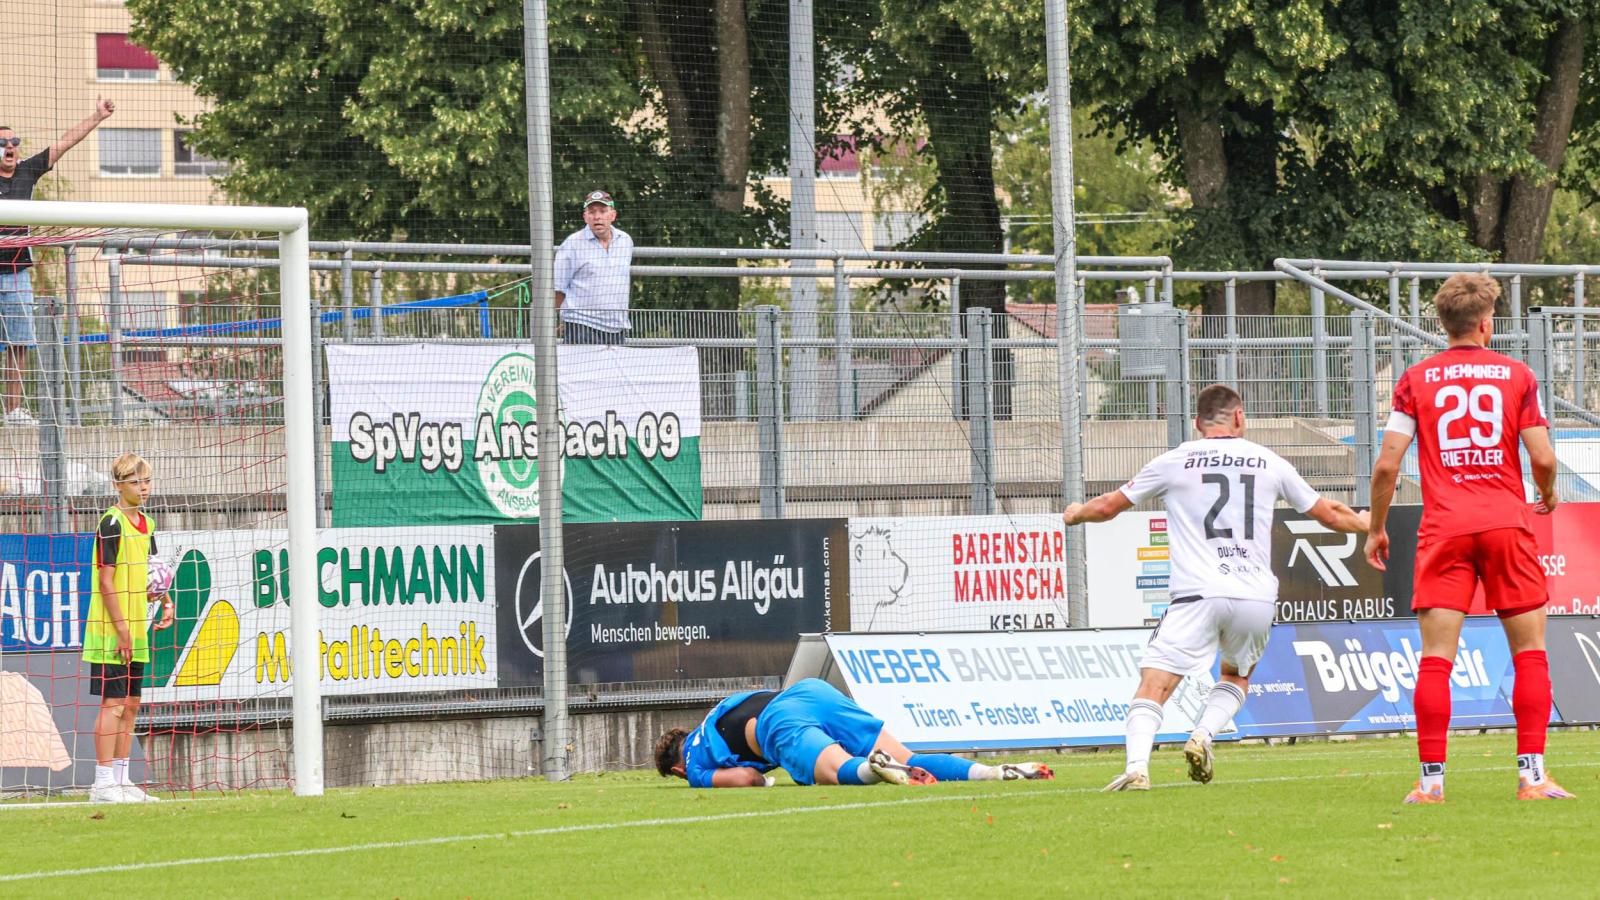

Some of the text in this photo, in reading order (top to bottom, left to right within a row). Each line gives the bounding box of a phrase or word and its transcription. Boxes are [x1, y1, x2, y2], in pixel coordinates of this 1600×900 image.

[1425, 364, 1511, 383] FC MEMMINGEN
[1434, 384, 1503, 450] 29
[349, 411, 681, 474] SpVgg Ansach 09
[1440, 450, 1503, 467] RIETZLER
[1184, 454, 1267, 469] ansbach
[1201, 473, 1255, 540] 21
[952, 531, 1064, 565] BÄRENSTAR
[1538, 554, 1566, 576] sse
[589, 554, 804, 615] Autohaus Allgäu
[954, 567, 1065, 603] MANNSCHA
[0, 561, 83, 648] ACH
[1343, 597, 1395, 619] RABUS
[591, 621, 711, 645] Menschen bewegen.
[255, 620, 487, 684] Mtalltechnik
[838, 643, 1144, 684] WEBER BAUELEMENTE
[1292, 637, 1490, 702] Brügeleir
[903, 701, 961, 728] Türen
[973, 701, 1039, 726] Fenster
[1055, 698, 1130, 724] Rollladen
